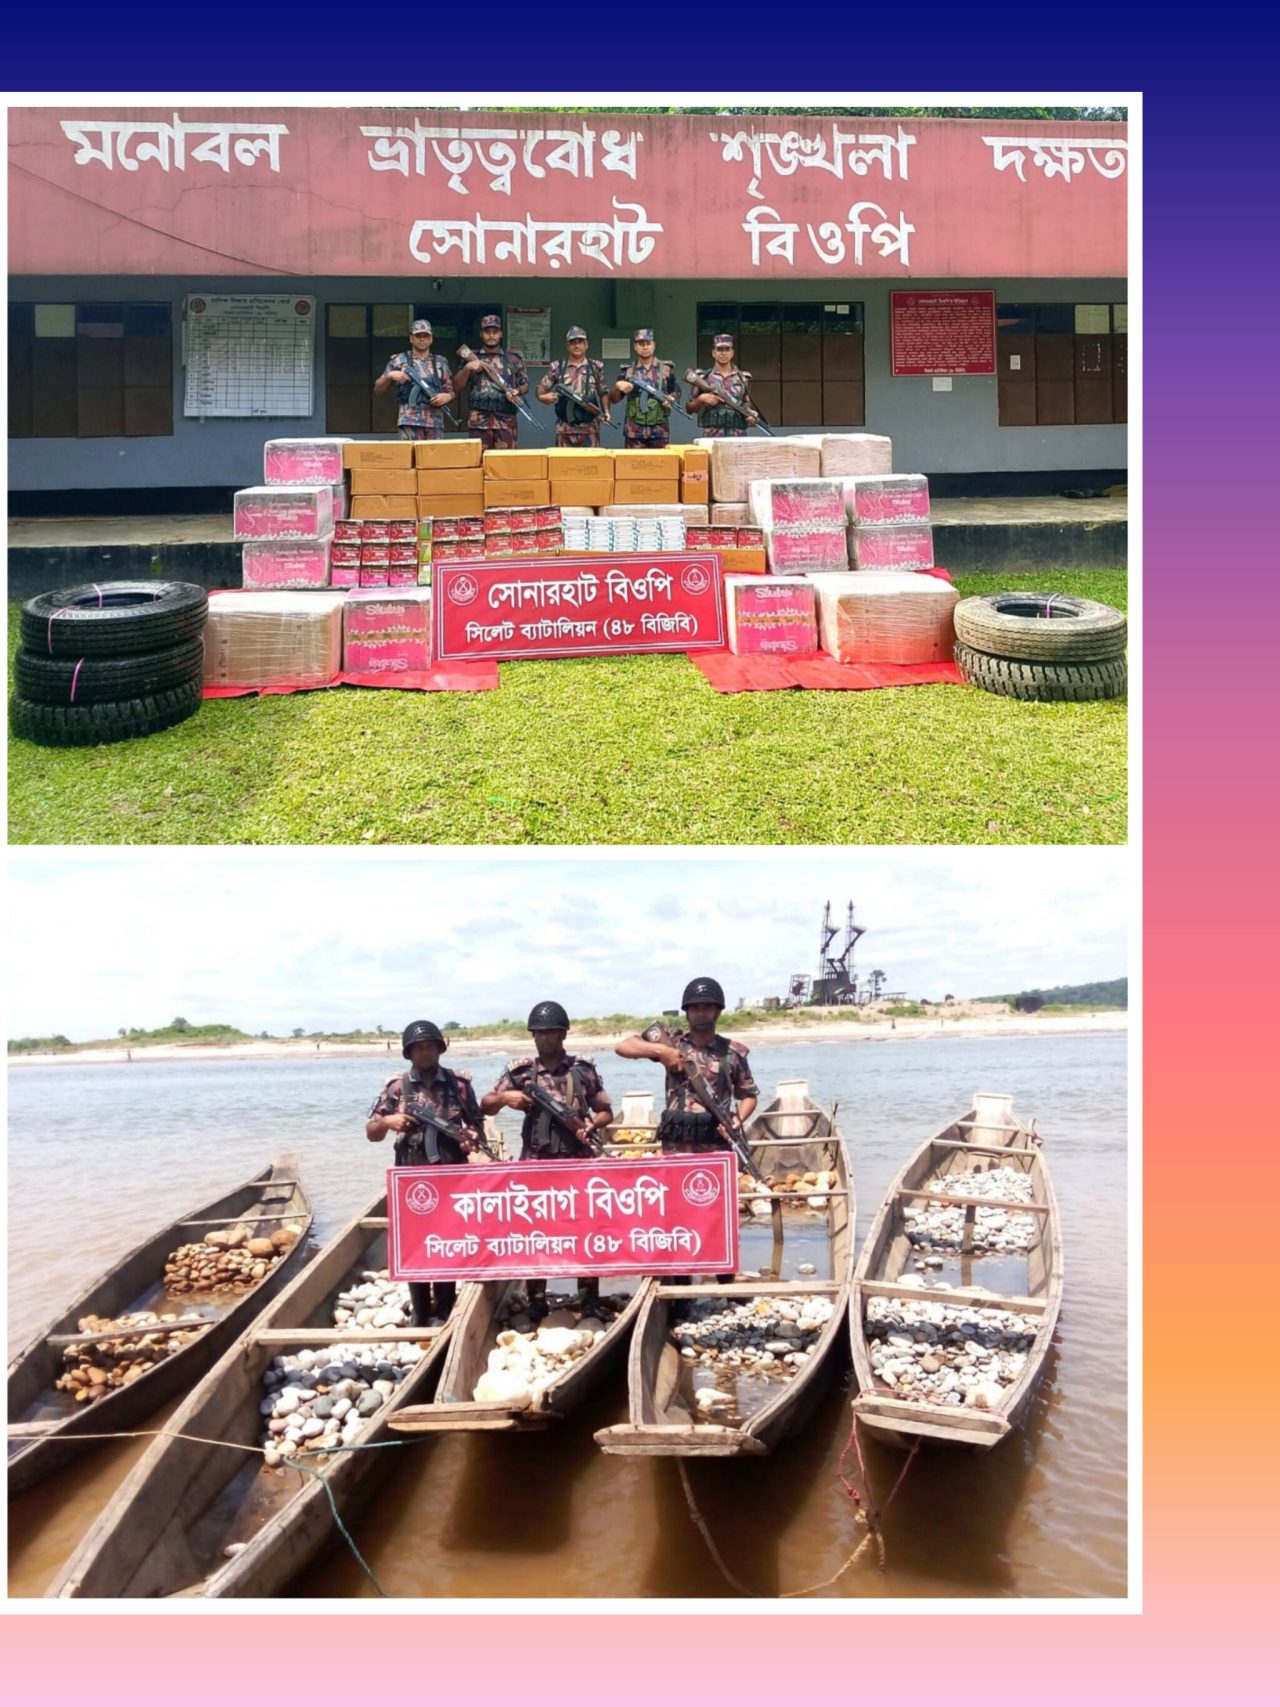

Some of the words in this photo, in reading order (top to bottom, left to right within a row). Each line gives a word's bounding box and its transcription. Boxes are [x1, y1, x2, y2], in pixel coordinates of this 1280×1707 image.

[60, 113, 289, 172] মনোবল
[360, 118, 643, 195] ভ্রাতৃত্ববোধ
[409, 195, 663, 269] সোনারহাট
[742, 202, 915, 266] বিওপি
[489, 572, 599, 608] সোনারহাট
[606, 568, 673, 602] বিওপি
[465, 621, 514, 643] সিলেট
[520, 617, 598, 640] ব্যাটালিয়ন
[603, 618, 635, 640] (৪৮
[640, 612, 698, 636] বিজিবি)
[450, 1181, 579, 1223] কালাইরাগ
[585, 1176, 668, 1218] বিওপি
[425, 1234, 480, 1258] সিলেট
[485, 1231, 577, 1256] ব্যাটালিয়ন
[584, 1233, 622, 1258] (৪৮
[629, 1226, 701, 1256] বিজিবি)
